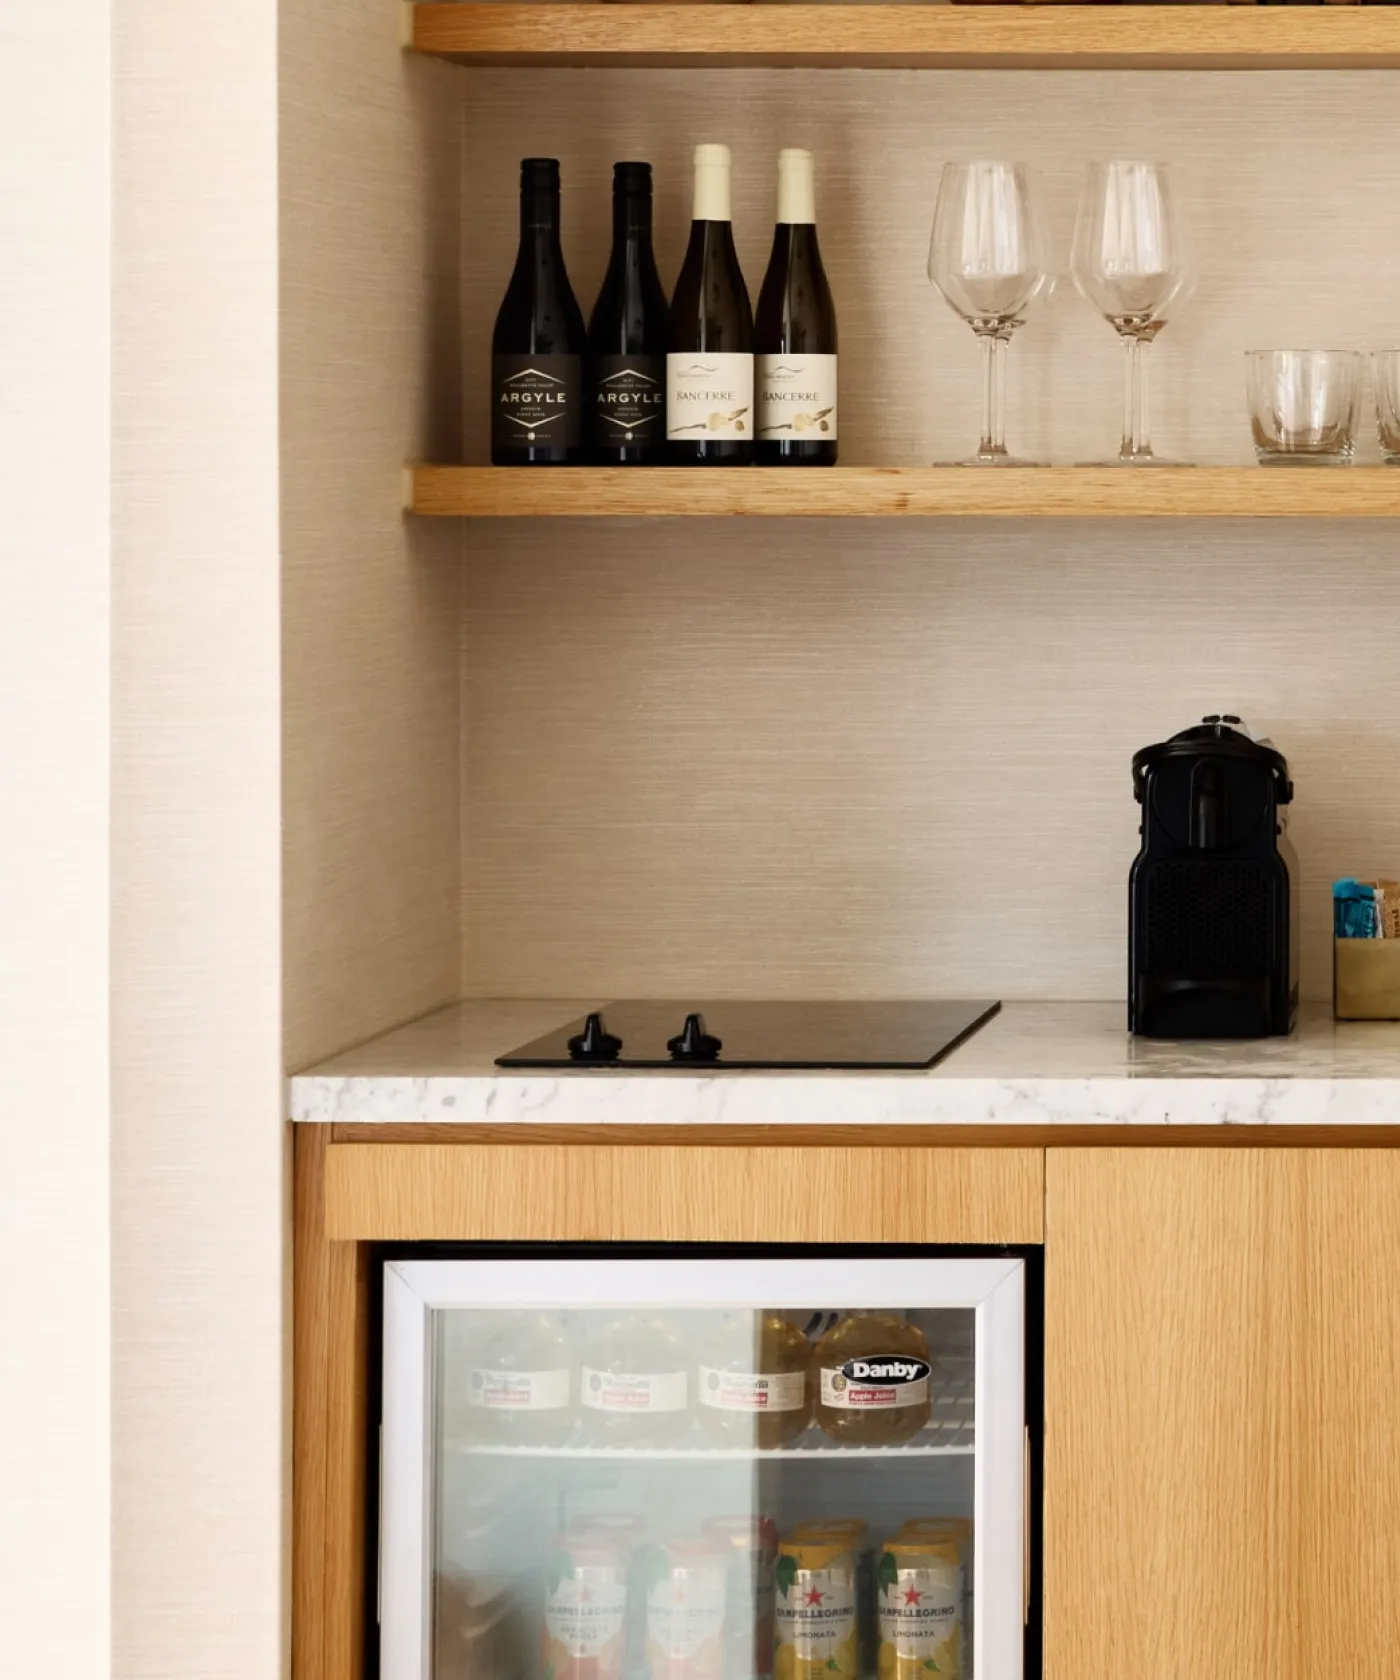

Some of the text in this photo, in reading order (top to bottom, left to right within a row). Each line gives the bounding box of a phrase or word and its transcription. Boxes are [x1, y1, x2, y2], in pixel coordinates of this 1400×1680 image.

[500, 392, 567, 403] ARGYLE
[597, 393, 662, 403] ARGYLE
[676, 391, 736, 401] SANCERRE
[762, 391, 821, 401] SANCERRE
[853, 1362, 919, 1380] Danby
[793, 1630, 836, 1639] LIMONATA
[892, 1630, 935, 1638] LIMONATA
